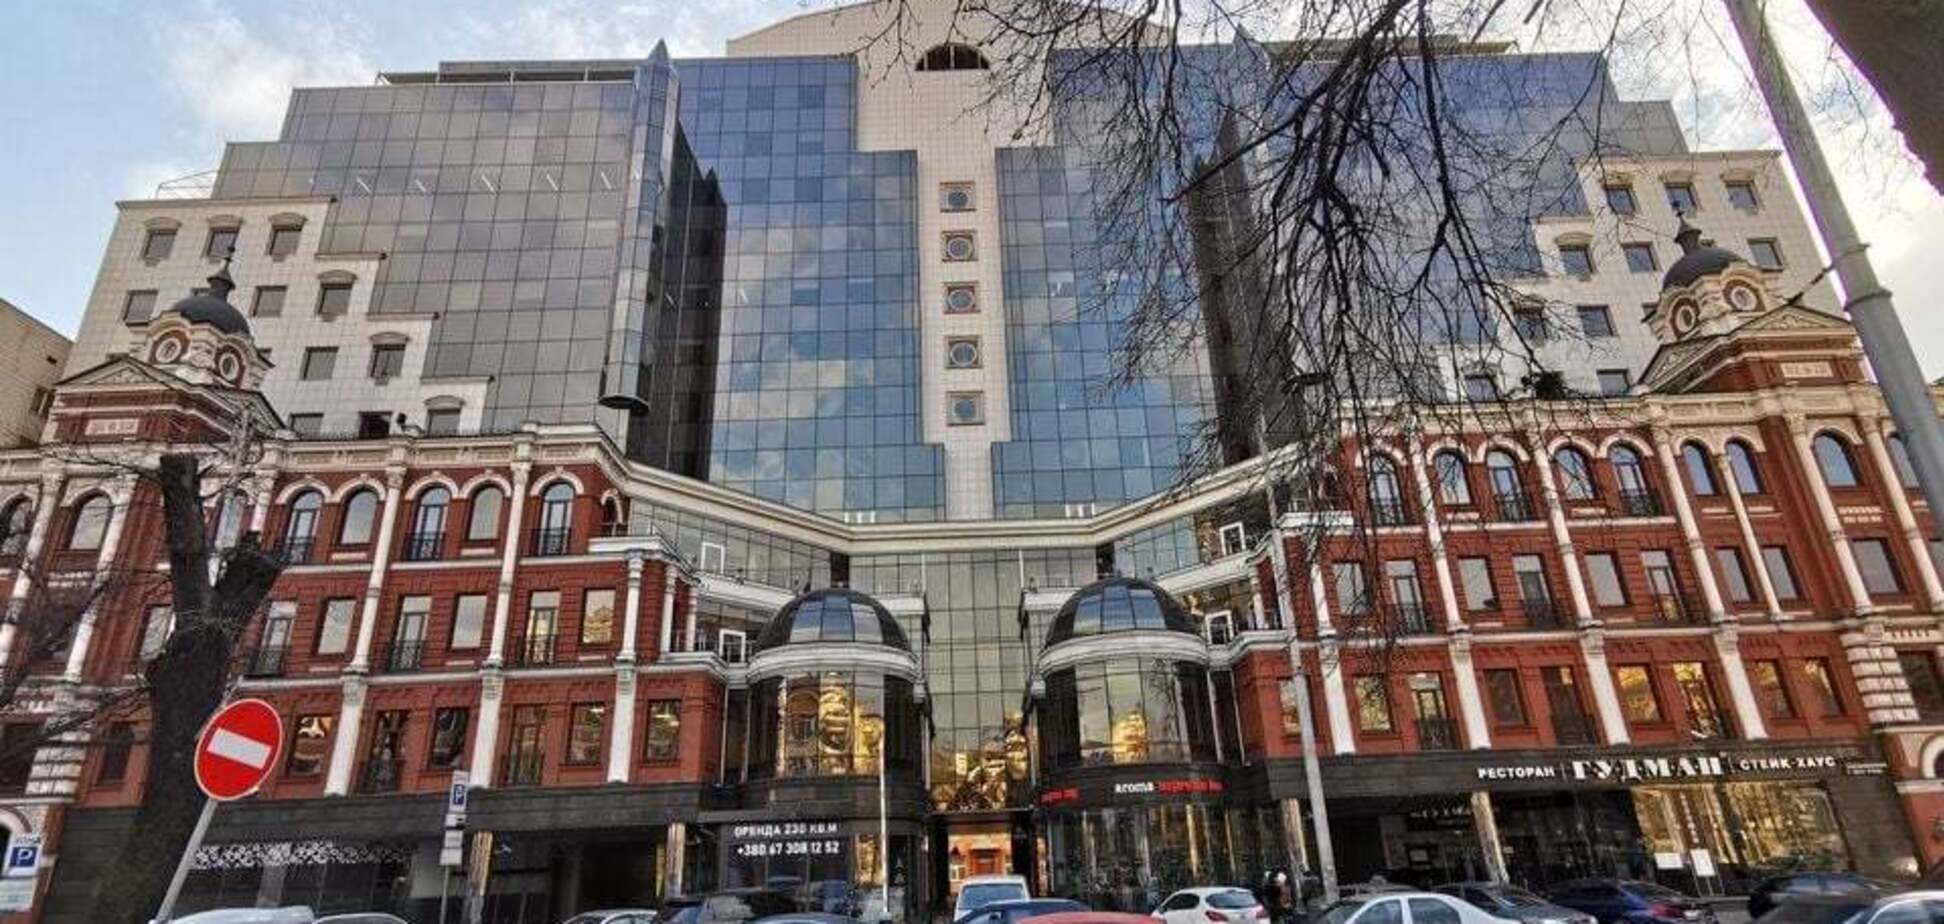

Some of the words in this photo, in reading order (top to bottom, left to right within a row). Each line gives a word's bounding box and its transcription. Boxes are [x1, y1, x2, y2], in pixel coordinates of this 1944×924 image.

[1478, 765, 1555, 779] РЕСТОРАН
[1114, 782, 1154, 794] aroma
[811, 842, 822, 852] 12
